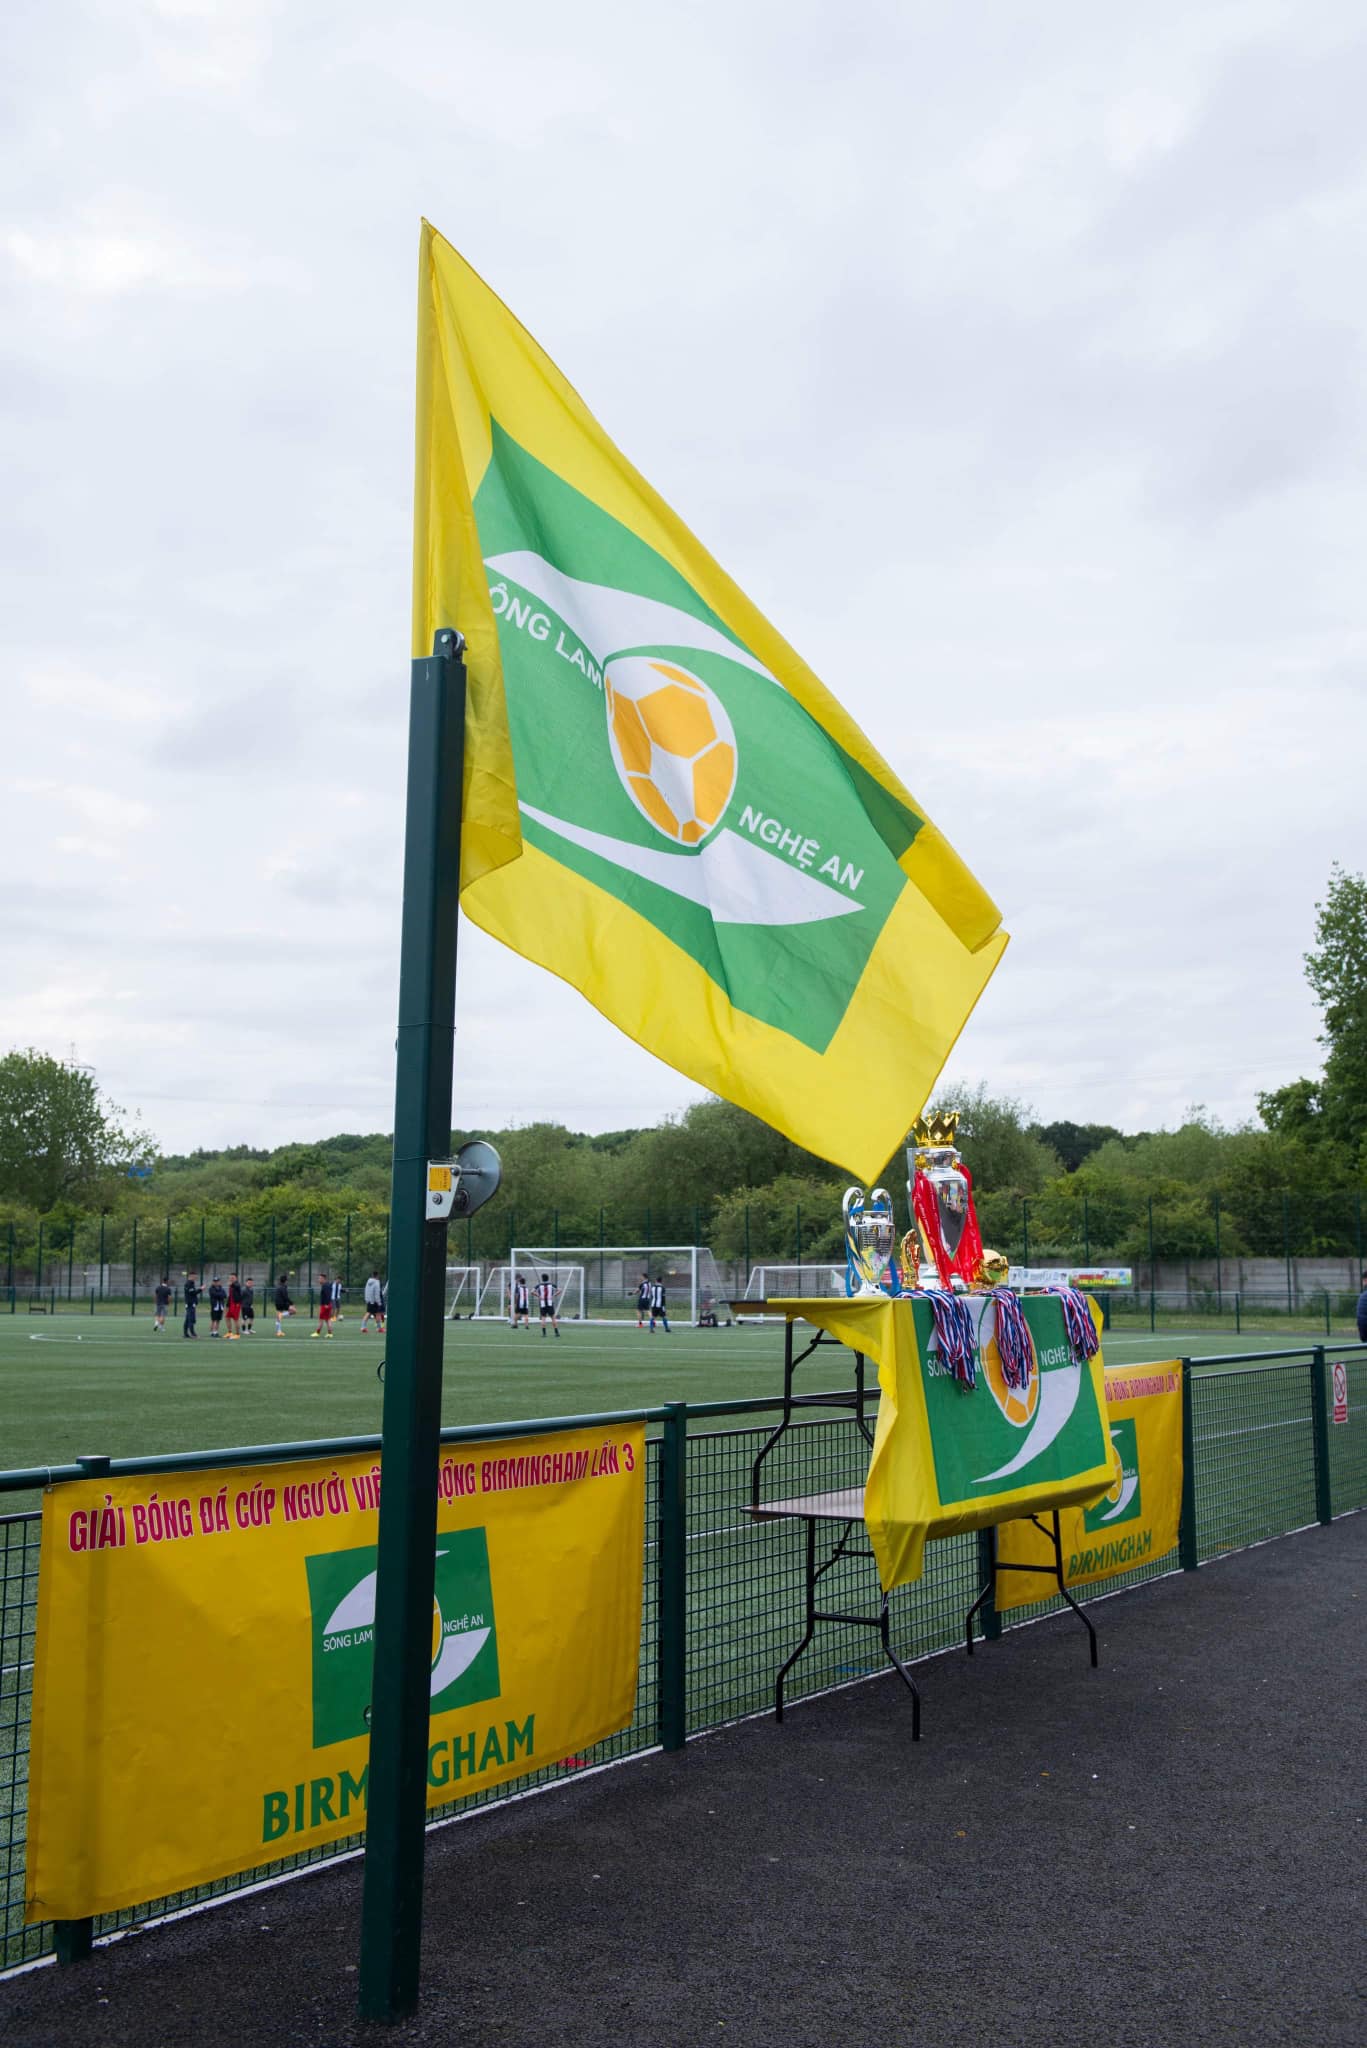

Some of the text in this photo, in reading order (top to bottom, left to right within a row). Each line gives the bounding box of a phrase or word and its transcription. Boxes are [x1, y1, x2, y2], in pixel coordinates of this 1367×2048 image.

[489, 582, 602, 691] ÔNG LAM
[738, 805, 864, 891] NGHỆ AN
[69, 1494, 126, 1551] GIẢI
[132, 1492, 194, 1545] BÓNG
[199, 1486, 230, 1534] ĐÁ
[235, 1480, 276, 1529] CÚP
[283, 1471, 349, 1523] NGƯỜI
[438, 1458, 476, 1505] ỘNG
[481, 1449, 590, 1493] BIRMINGHAM
[622, 1442, 635, 1472] 3
[1067, 1528, 1152, 1578] BIRMINGHAM
[323, 1613, 484, 1652] SÔNG LAM NGHỆ AN
[262, 1714, 536, 1843] BIRMGHAM
